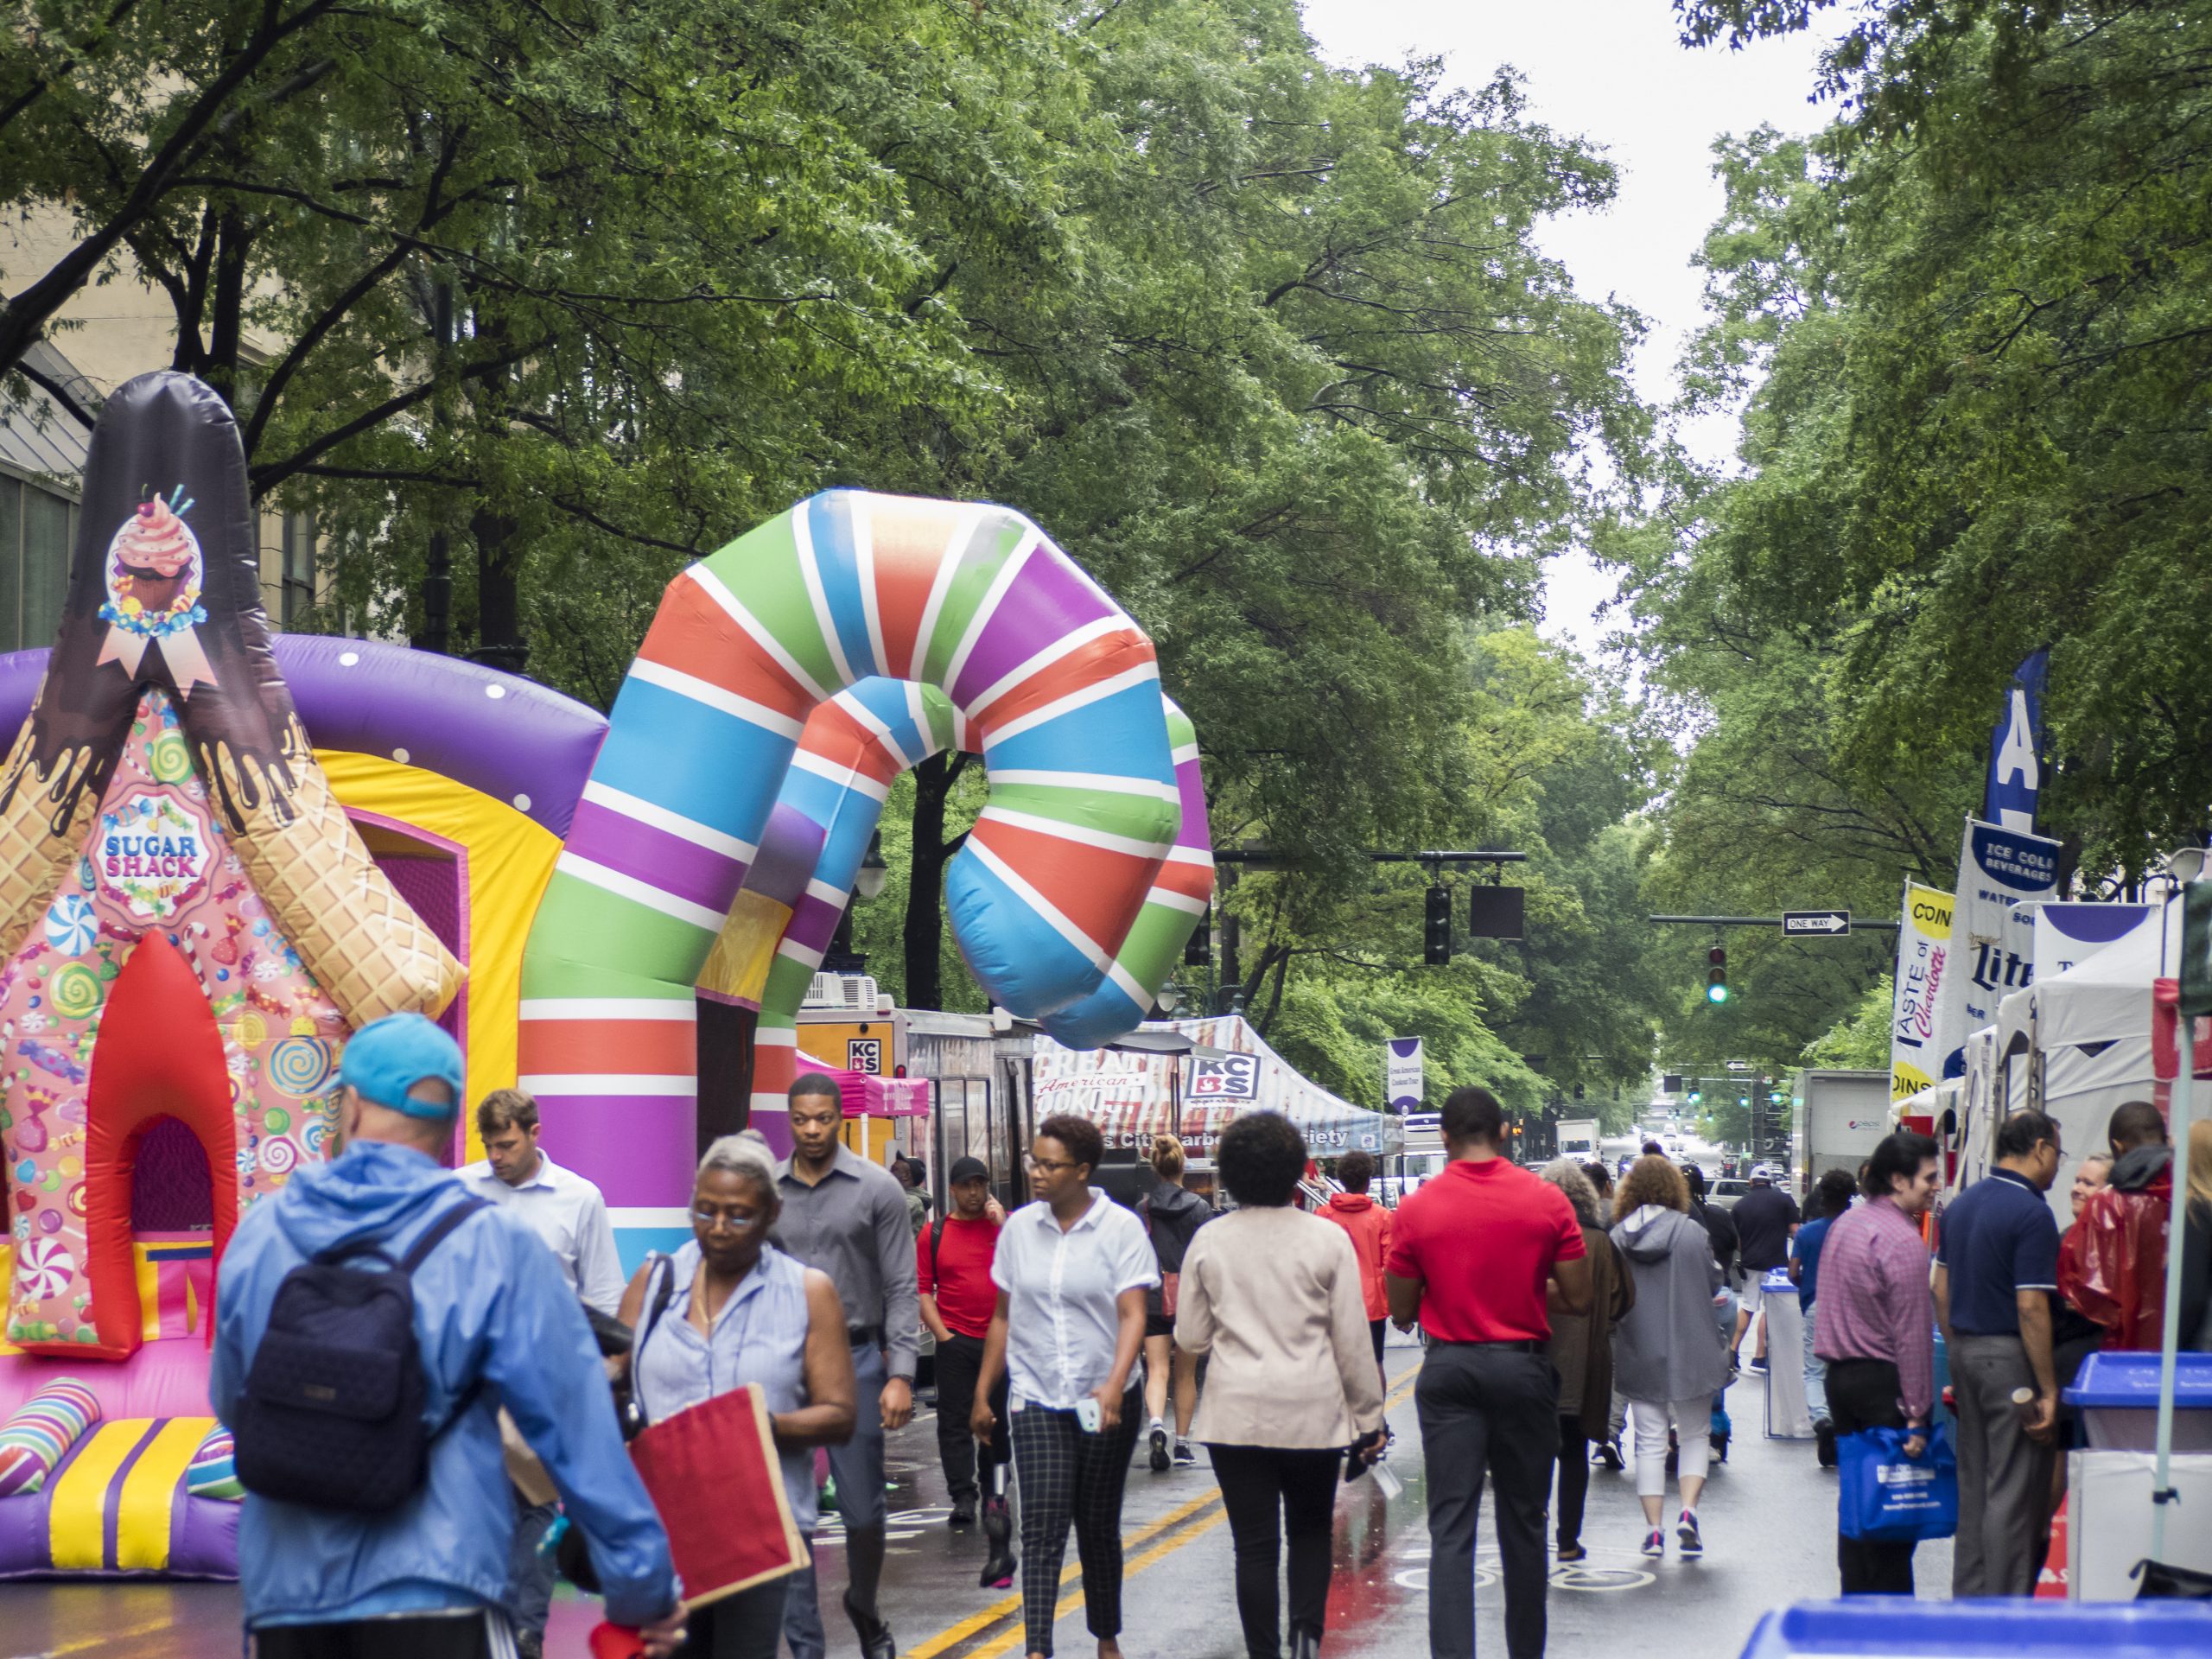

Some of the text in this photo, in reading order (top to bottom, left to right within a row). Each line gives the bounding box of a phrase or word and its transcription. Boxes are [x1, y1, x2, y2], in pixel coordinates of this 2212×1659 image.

[105, 836, 198, 856] SUGAR
[1986, 842, 2012, 860] ICE
[105, 856, 200, 877] SHACK
[1986, 857, 2052, 882] BEVERAGES
[1789, 918, 1829, 928] ONE WAY
[1916, 939, 1929, 957] of
[1913, 945, 1947, 1039] Charlotte
[1033, 1051, 1146, 1080] GREAT
[1039, 1075, 1128, 1093] American
